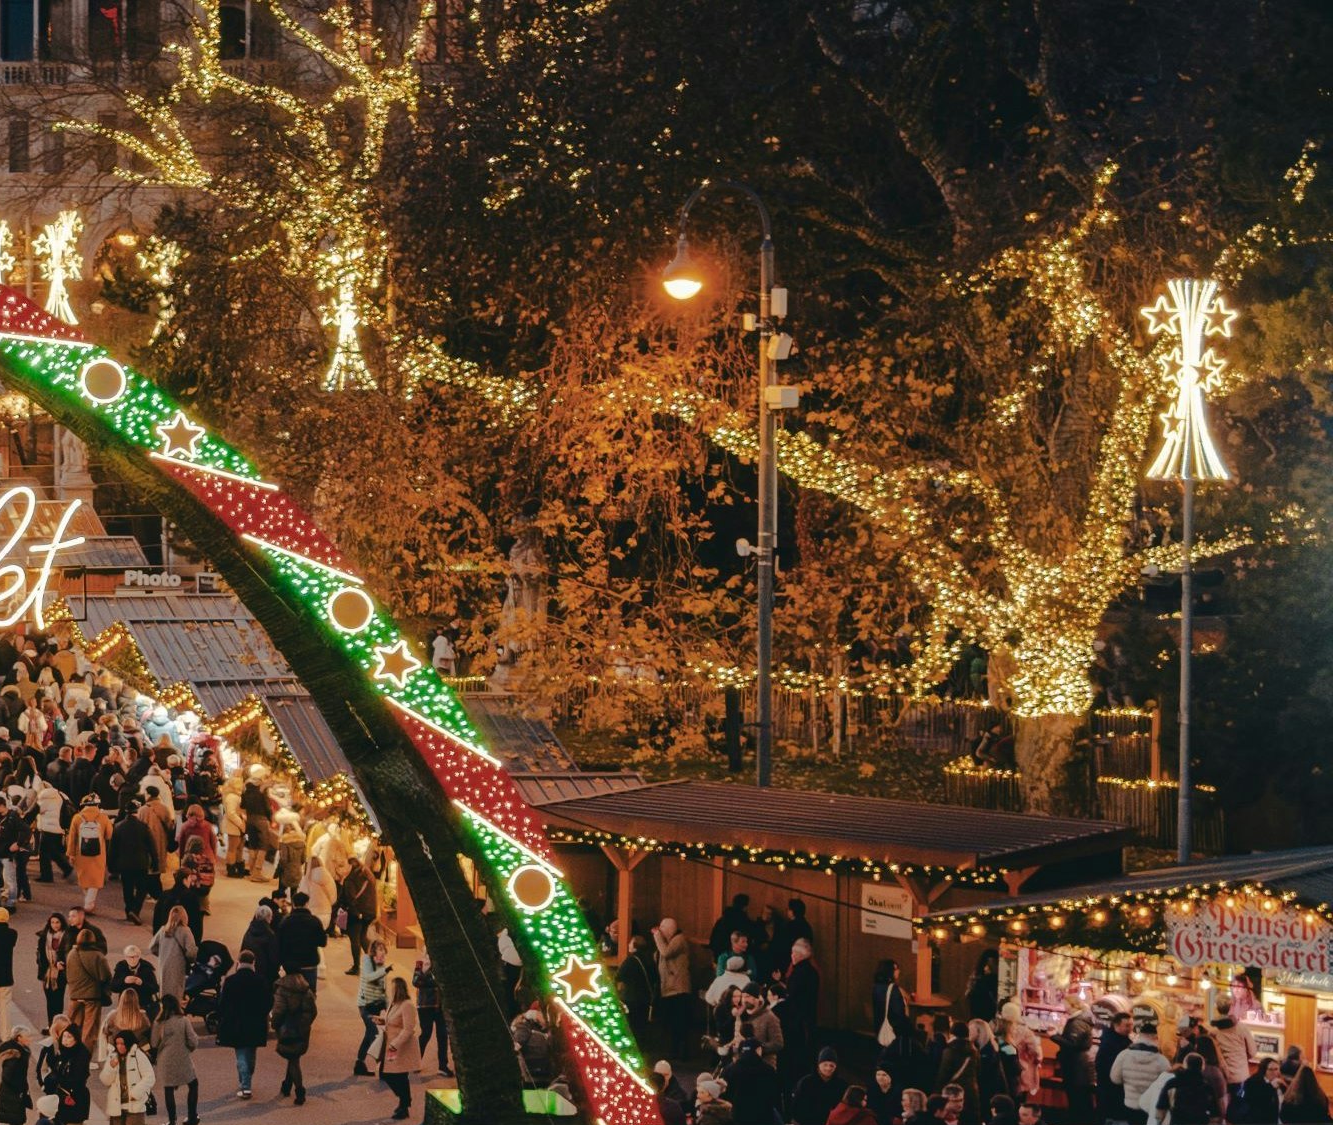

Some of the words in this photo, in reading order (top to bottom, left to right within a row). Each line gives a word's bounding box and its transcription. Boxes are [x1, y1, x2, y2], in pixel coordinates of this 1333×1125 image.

[124, 569, 182, 587] Photo
[1207, 900, 1317, 943] Punsch
[1175, 929, 1327, 972] Greisslerei
